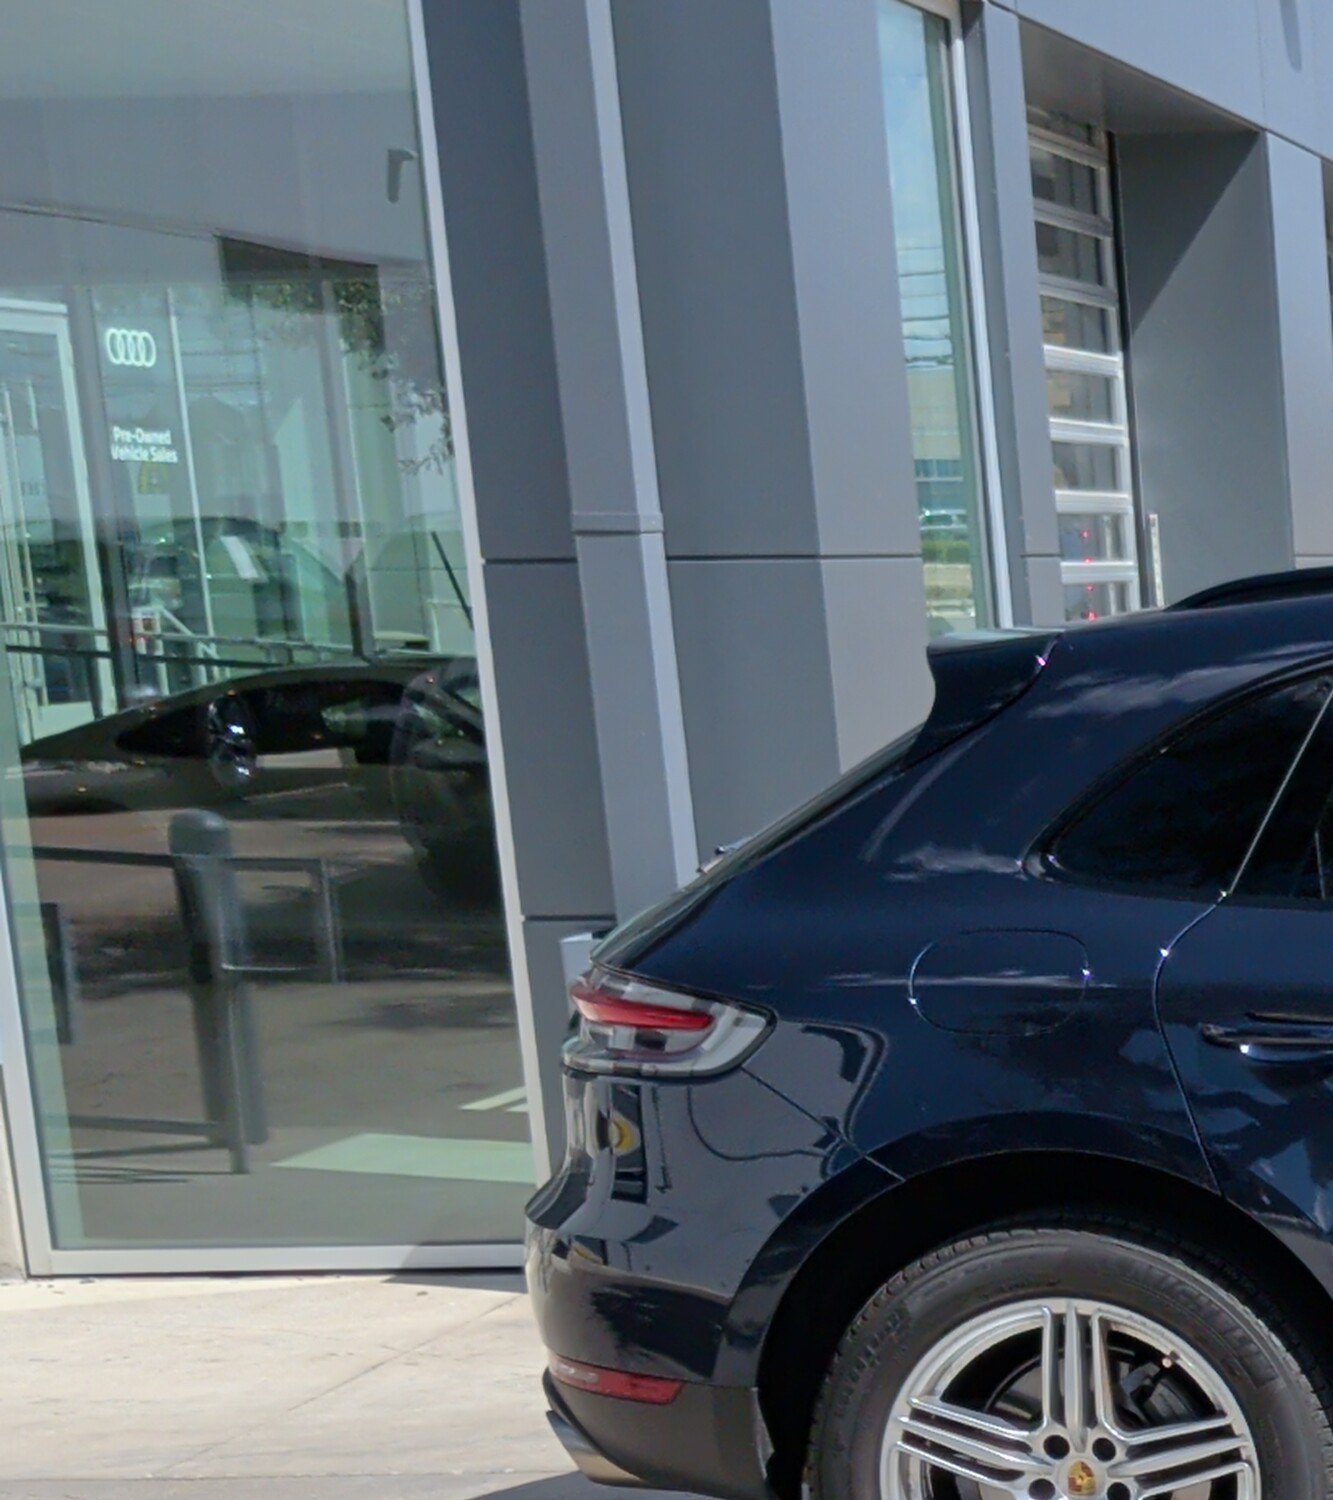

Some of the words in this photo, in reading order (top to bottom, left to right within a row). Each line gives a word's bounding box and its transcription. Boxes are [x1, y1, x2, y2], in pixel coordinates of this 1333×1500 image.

[112, 425, 172, 445] Pre-Owned
[110, 443, 150, 462] Vehicle
[149, 446, 178, 463] Sales
